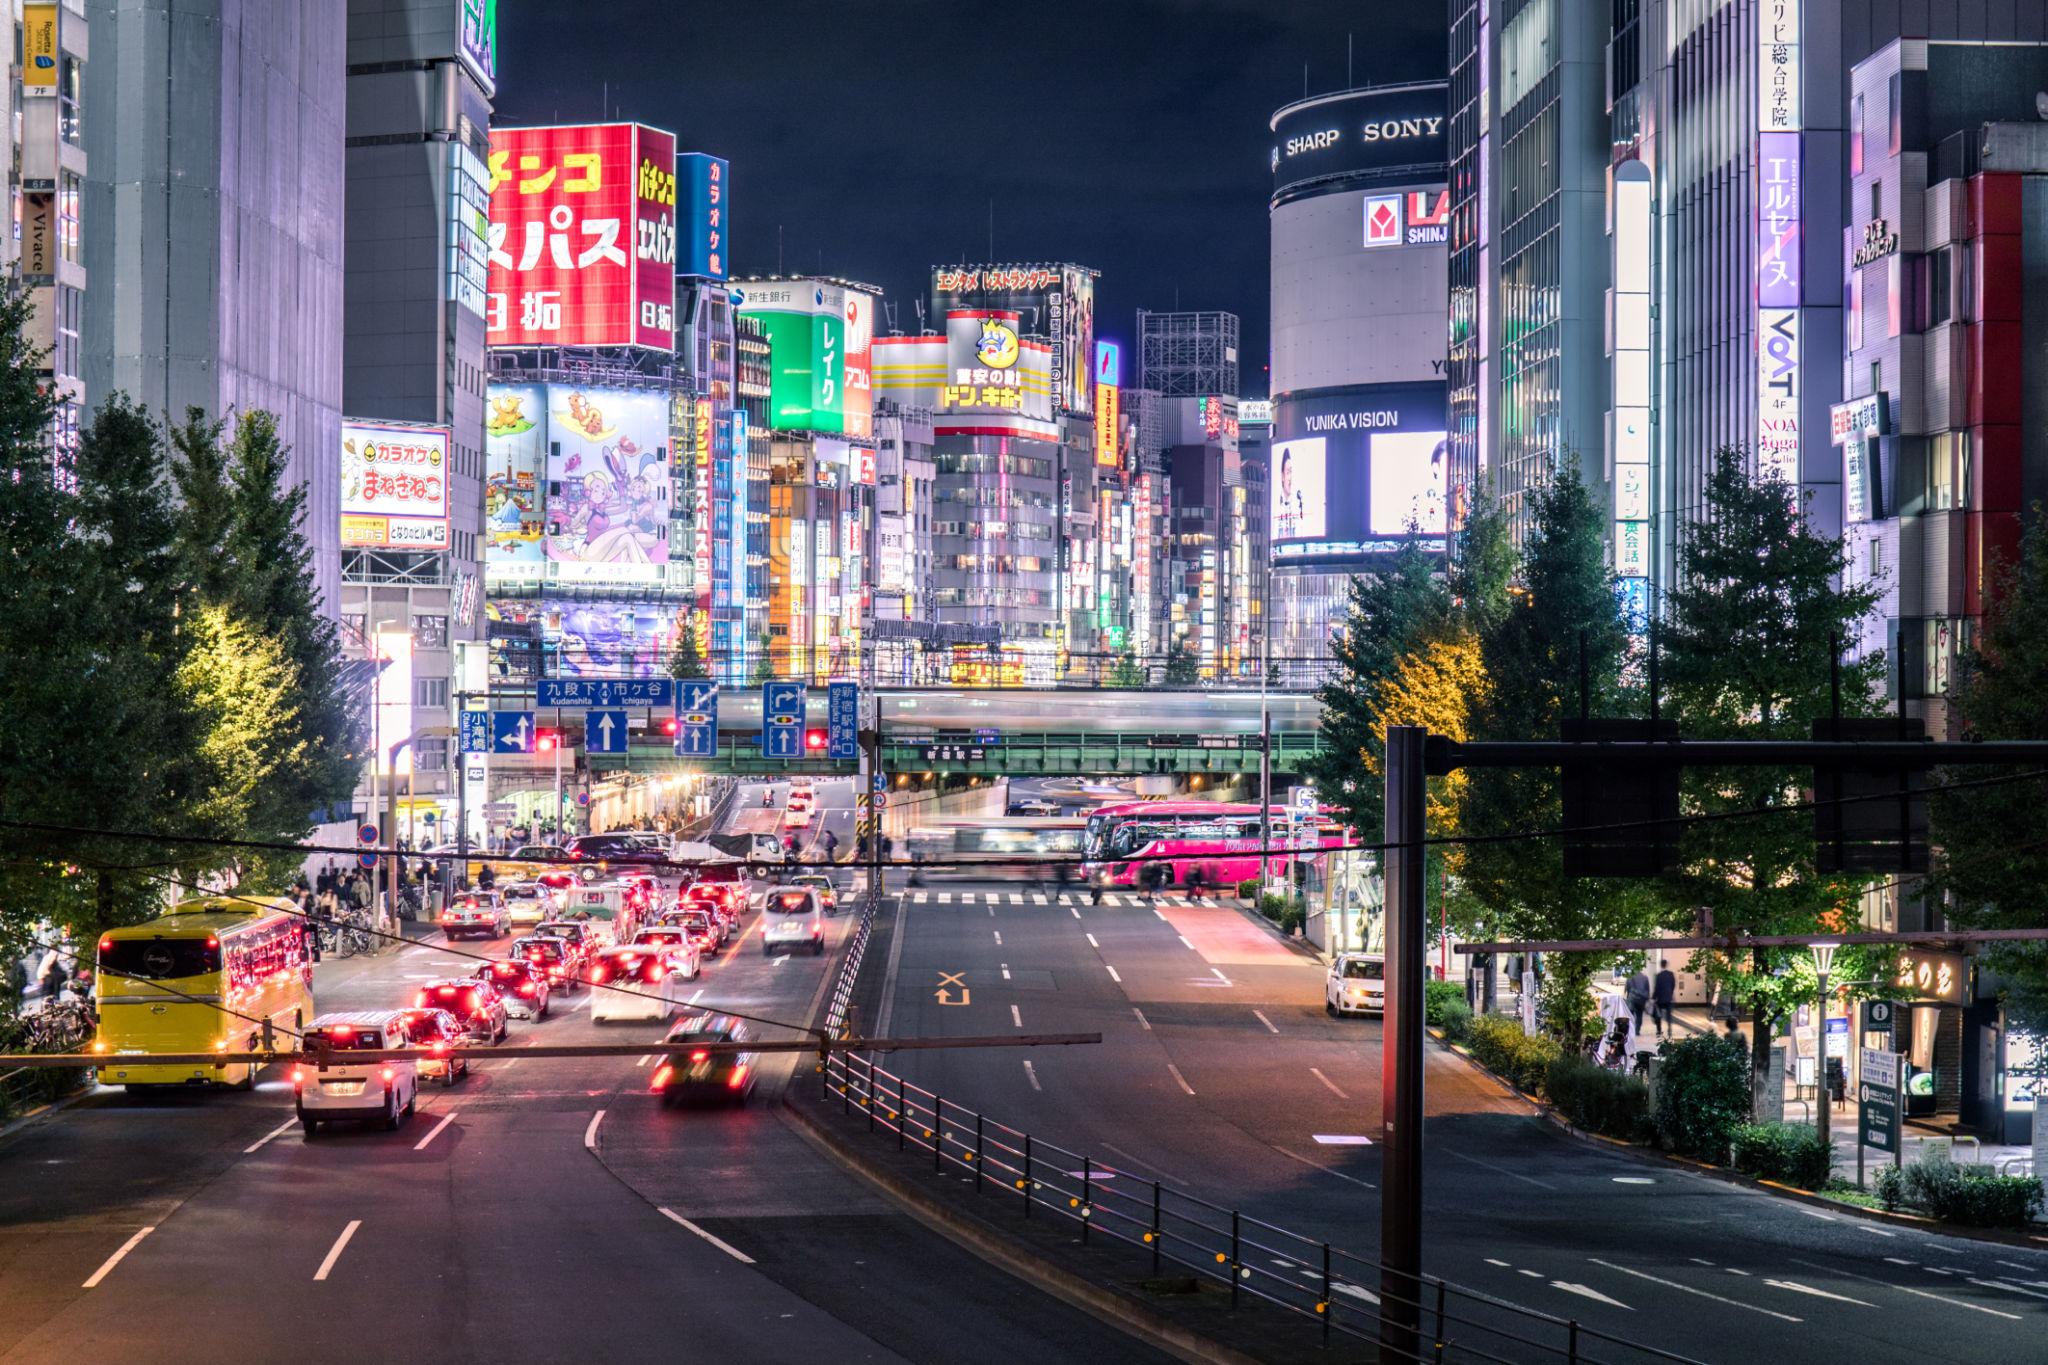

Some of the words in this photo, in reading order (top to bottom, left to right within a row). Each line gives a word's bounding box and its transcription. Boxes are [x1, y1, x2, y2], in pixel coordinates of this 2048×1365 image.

[45, 21, 53, 53] Rosetta
[34, 87, 47, 95] 7F
[1363, 116, 1443, 142] SONY
[1286, 129, 1341, 157] SHARP
[639, 158, 675, 206] パチンコ
[1765, 158, 1791, 288] エルセーヌ
[33, 213, 46, 271] Vivace
[638, 213, 675, 264] エスパス
[937, 271, 978, 291] エンタメ
[983, 270, 1061, 290] レストランタワー
[748, 290, 790, 302] 新生銀行
[822, 322, 835, 405] レイク
[845, 366, 870, 391] アコム
[1773, 399, 1787, 409] 4F
[696, 404, 709, 465] パチンコ
[1305, 413, 1348, 432] YUNIKA
[1350, 411, 1398, 428] VISION
[1762, 418, 1797, 432] NOA
[378, 445, 427, 463] カラオケ
[363, 470, 441, 501] まねきねこ
[696, 469, 709, 553] エスパス
[391, 527, 427, 540] となりのビル
[547, 682, 596, 696] 九段下
[550, 697, 593, 706] Kudanshita
[621, 697, 654, 707] Ichigaya
[832, 688, 841, 722] Shinjuku
[472, 713, 486, 750] 小滝橋
[841, 686, 854, 755] 新宿駅東口
